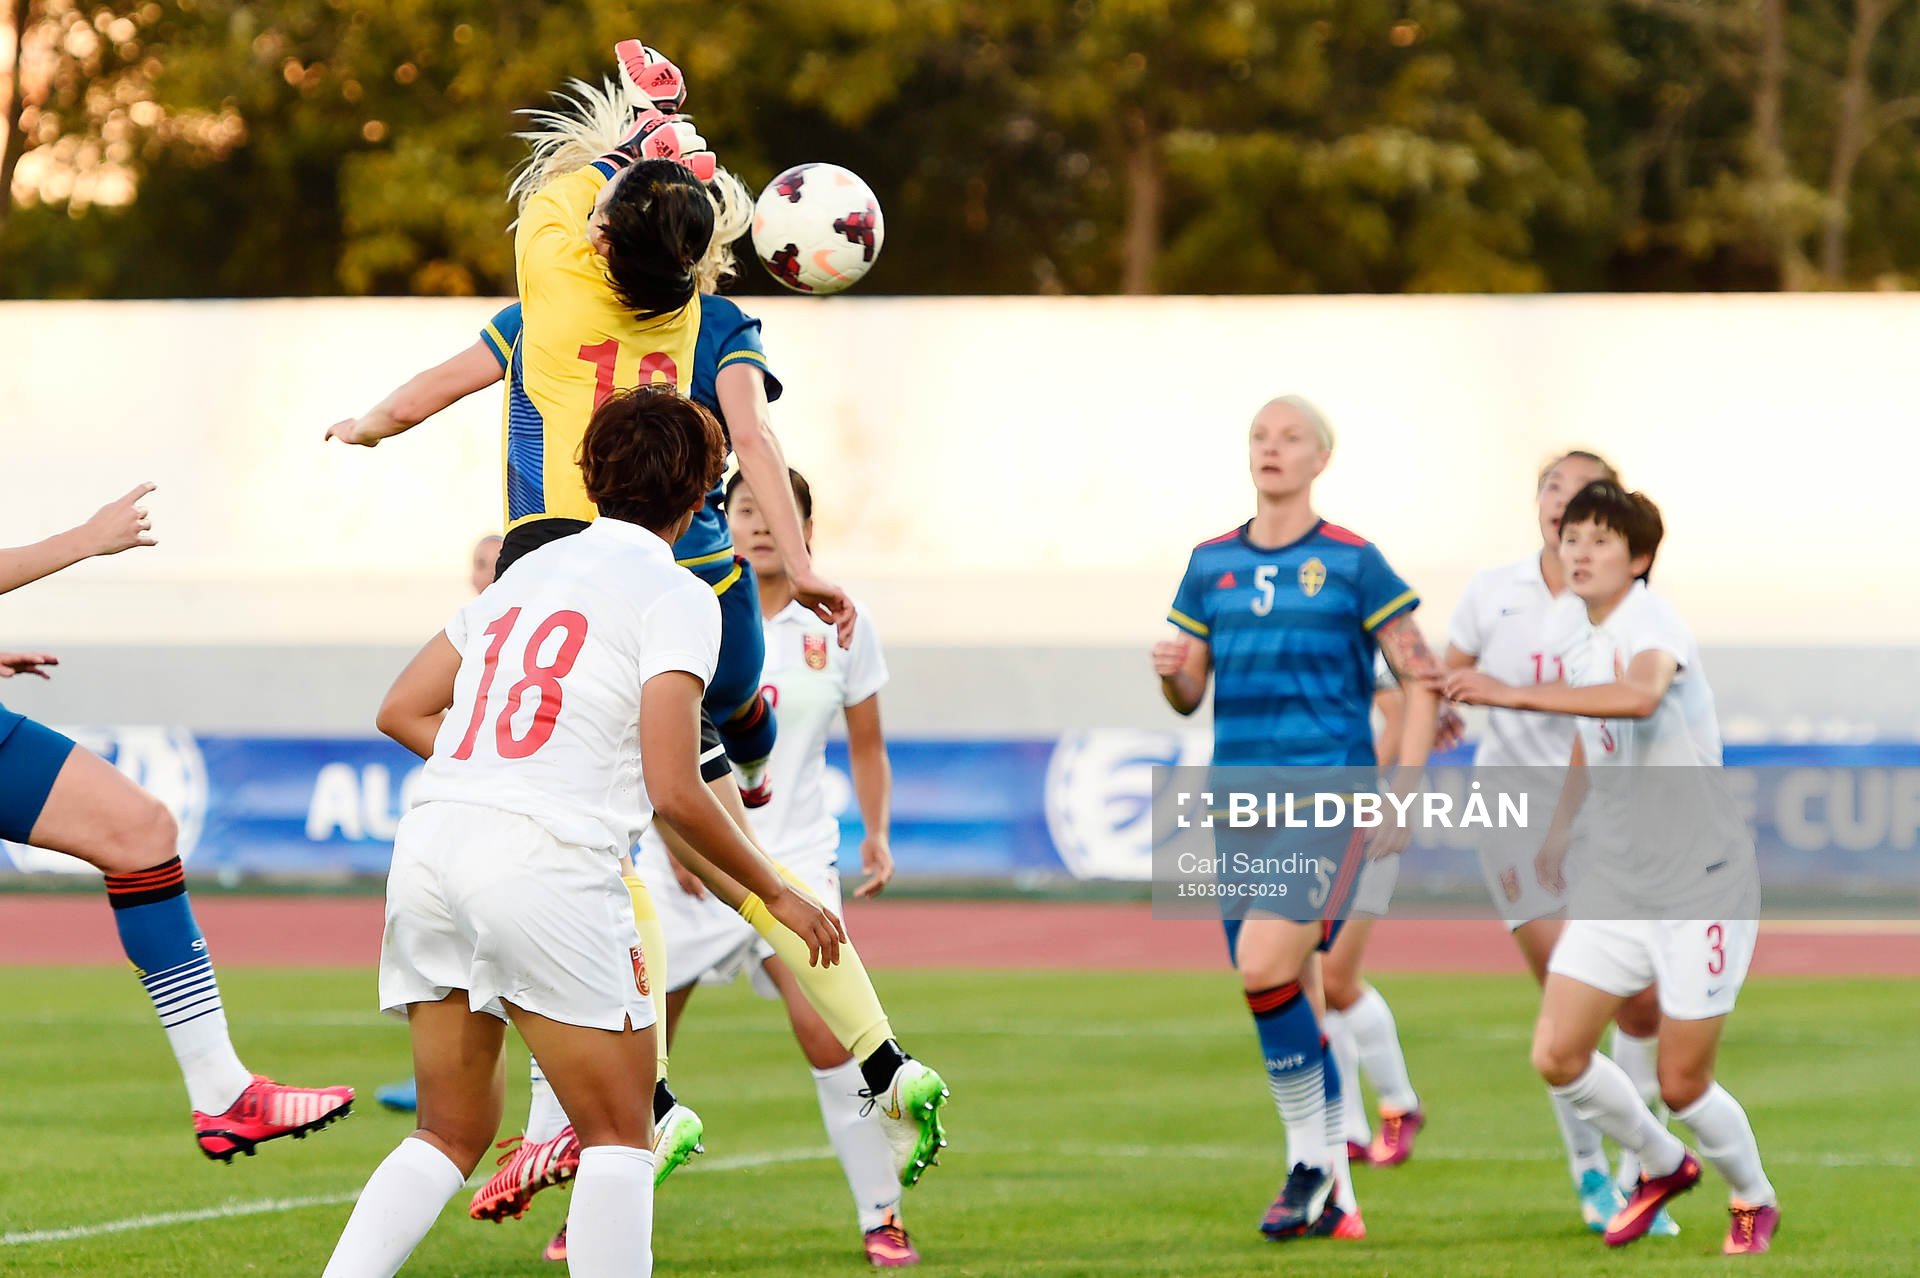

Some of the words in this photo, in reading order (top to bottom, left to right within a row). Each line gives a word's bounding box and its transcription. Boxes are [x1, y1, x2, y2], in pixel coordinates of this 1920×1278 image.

[1249, 564, 1279, 617] 5
[450, 606, 588, 761] 18
[1307, 856, 1337, 910] 5
[1706, 924, 1726, 976] 3
